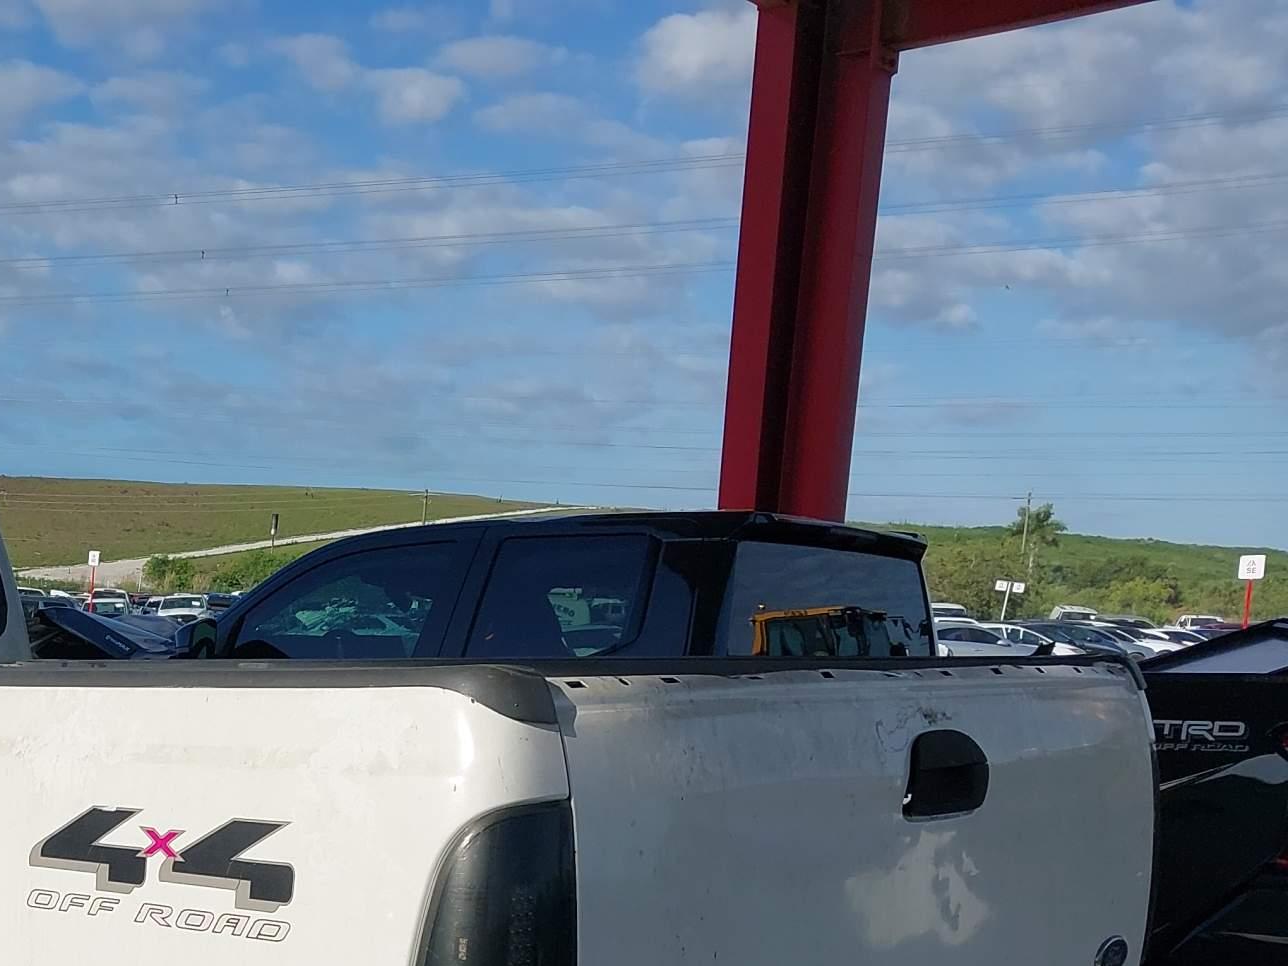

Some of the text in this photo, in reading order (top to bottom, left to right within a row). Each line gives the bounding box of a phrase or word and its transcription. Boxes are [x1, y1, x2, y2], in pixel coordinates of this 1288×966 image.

[1153, 720, 1246, 741] TRD
[26, 888, 292, 943] OFF ROAD
